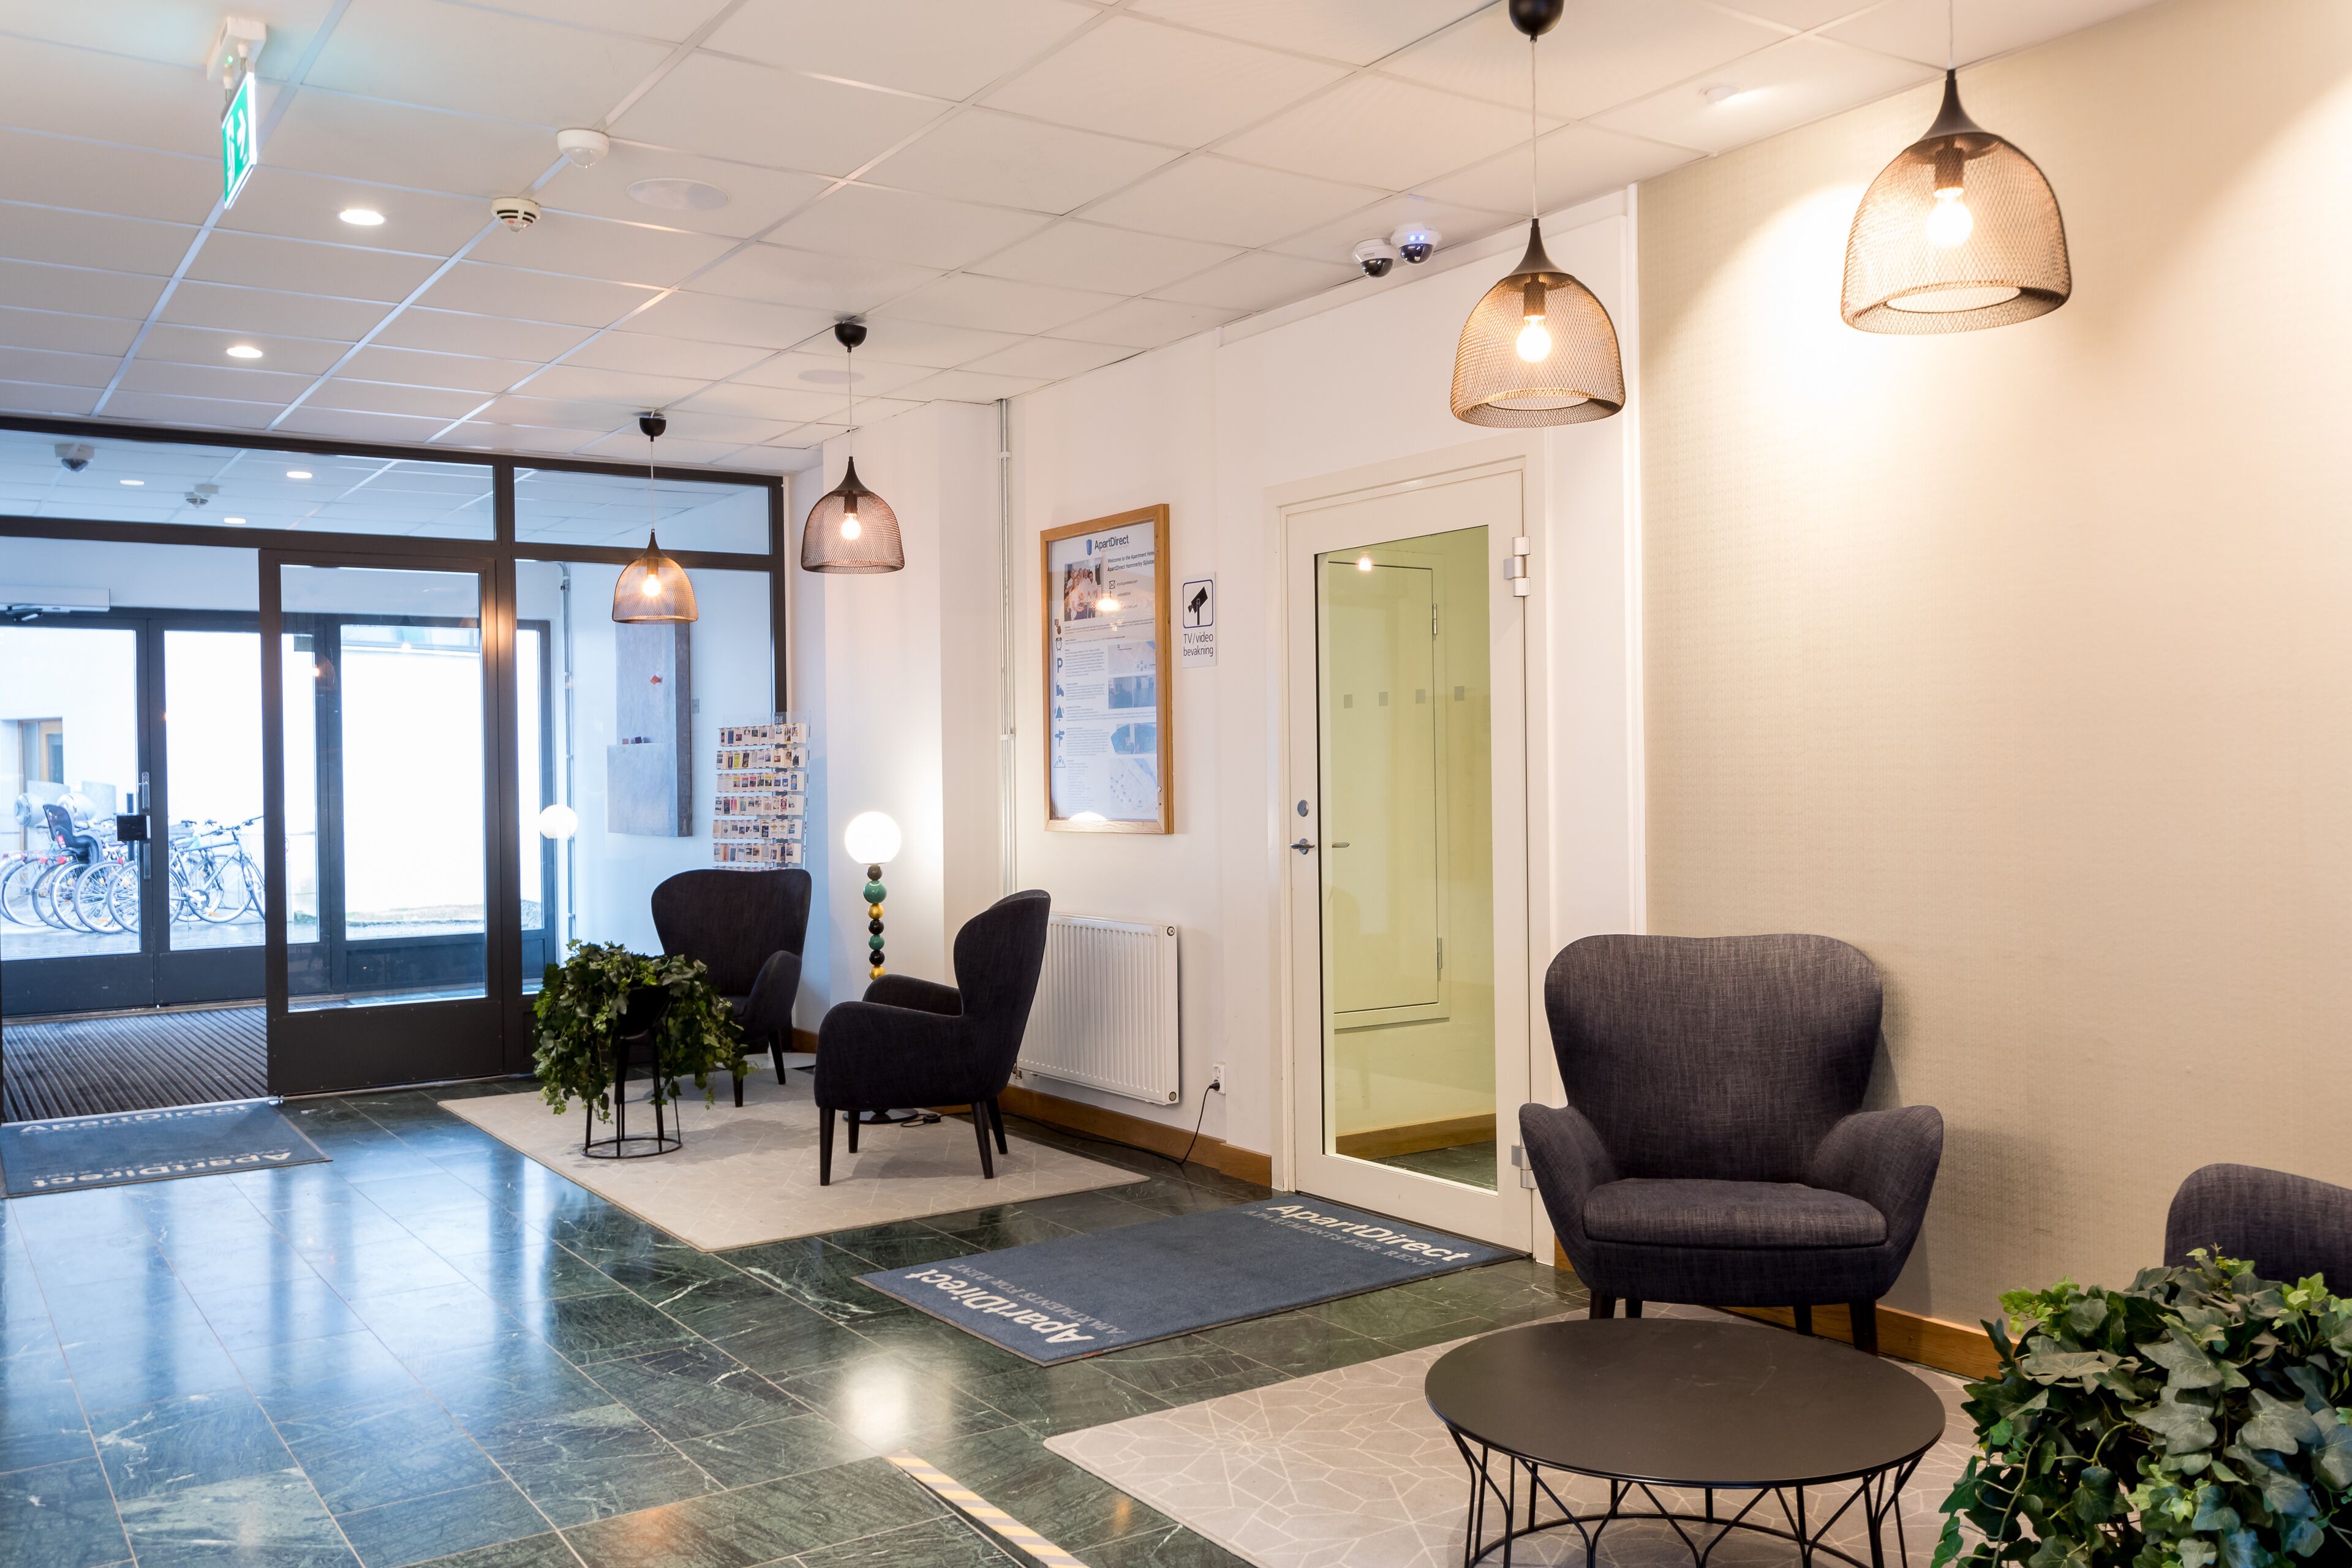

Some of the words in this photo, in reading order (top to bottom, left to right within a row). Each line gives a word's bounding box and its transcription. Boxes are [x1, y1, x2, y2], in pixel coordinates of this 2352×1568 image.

[1094, 534, 1129, 551] ApartDirect
[1183, 631, 1213, 644] TV/video
[1183, 645, 1213, 657] bevakning
[1057, 657, 1063, 673] P
[20, 1105, 249, 1133] ApartDirect
[32, 1152, 292, 1188] ApartDirect
[1242, 1210, 1348, 1240] APARTMENTS
[1343, 1239, 1381, 1251] FOR
[1381, 1250, 1436, 1266] RENT
[1265, 1205, 1471, 1262] ApartDirect
[949, 1264, 995, 1281] RENT
[990, 1279, 1026, 1299] FOR
[904, 1268, 1095, 1343] ApartDirect
[1019, 1292, 1126, 1334] APARTMENTS
